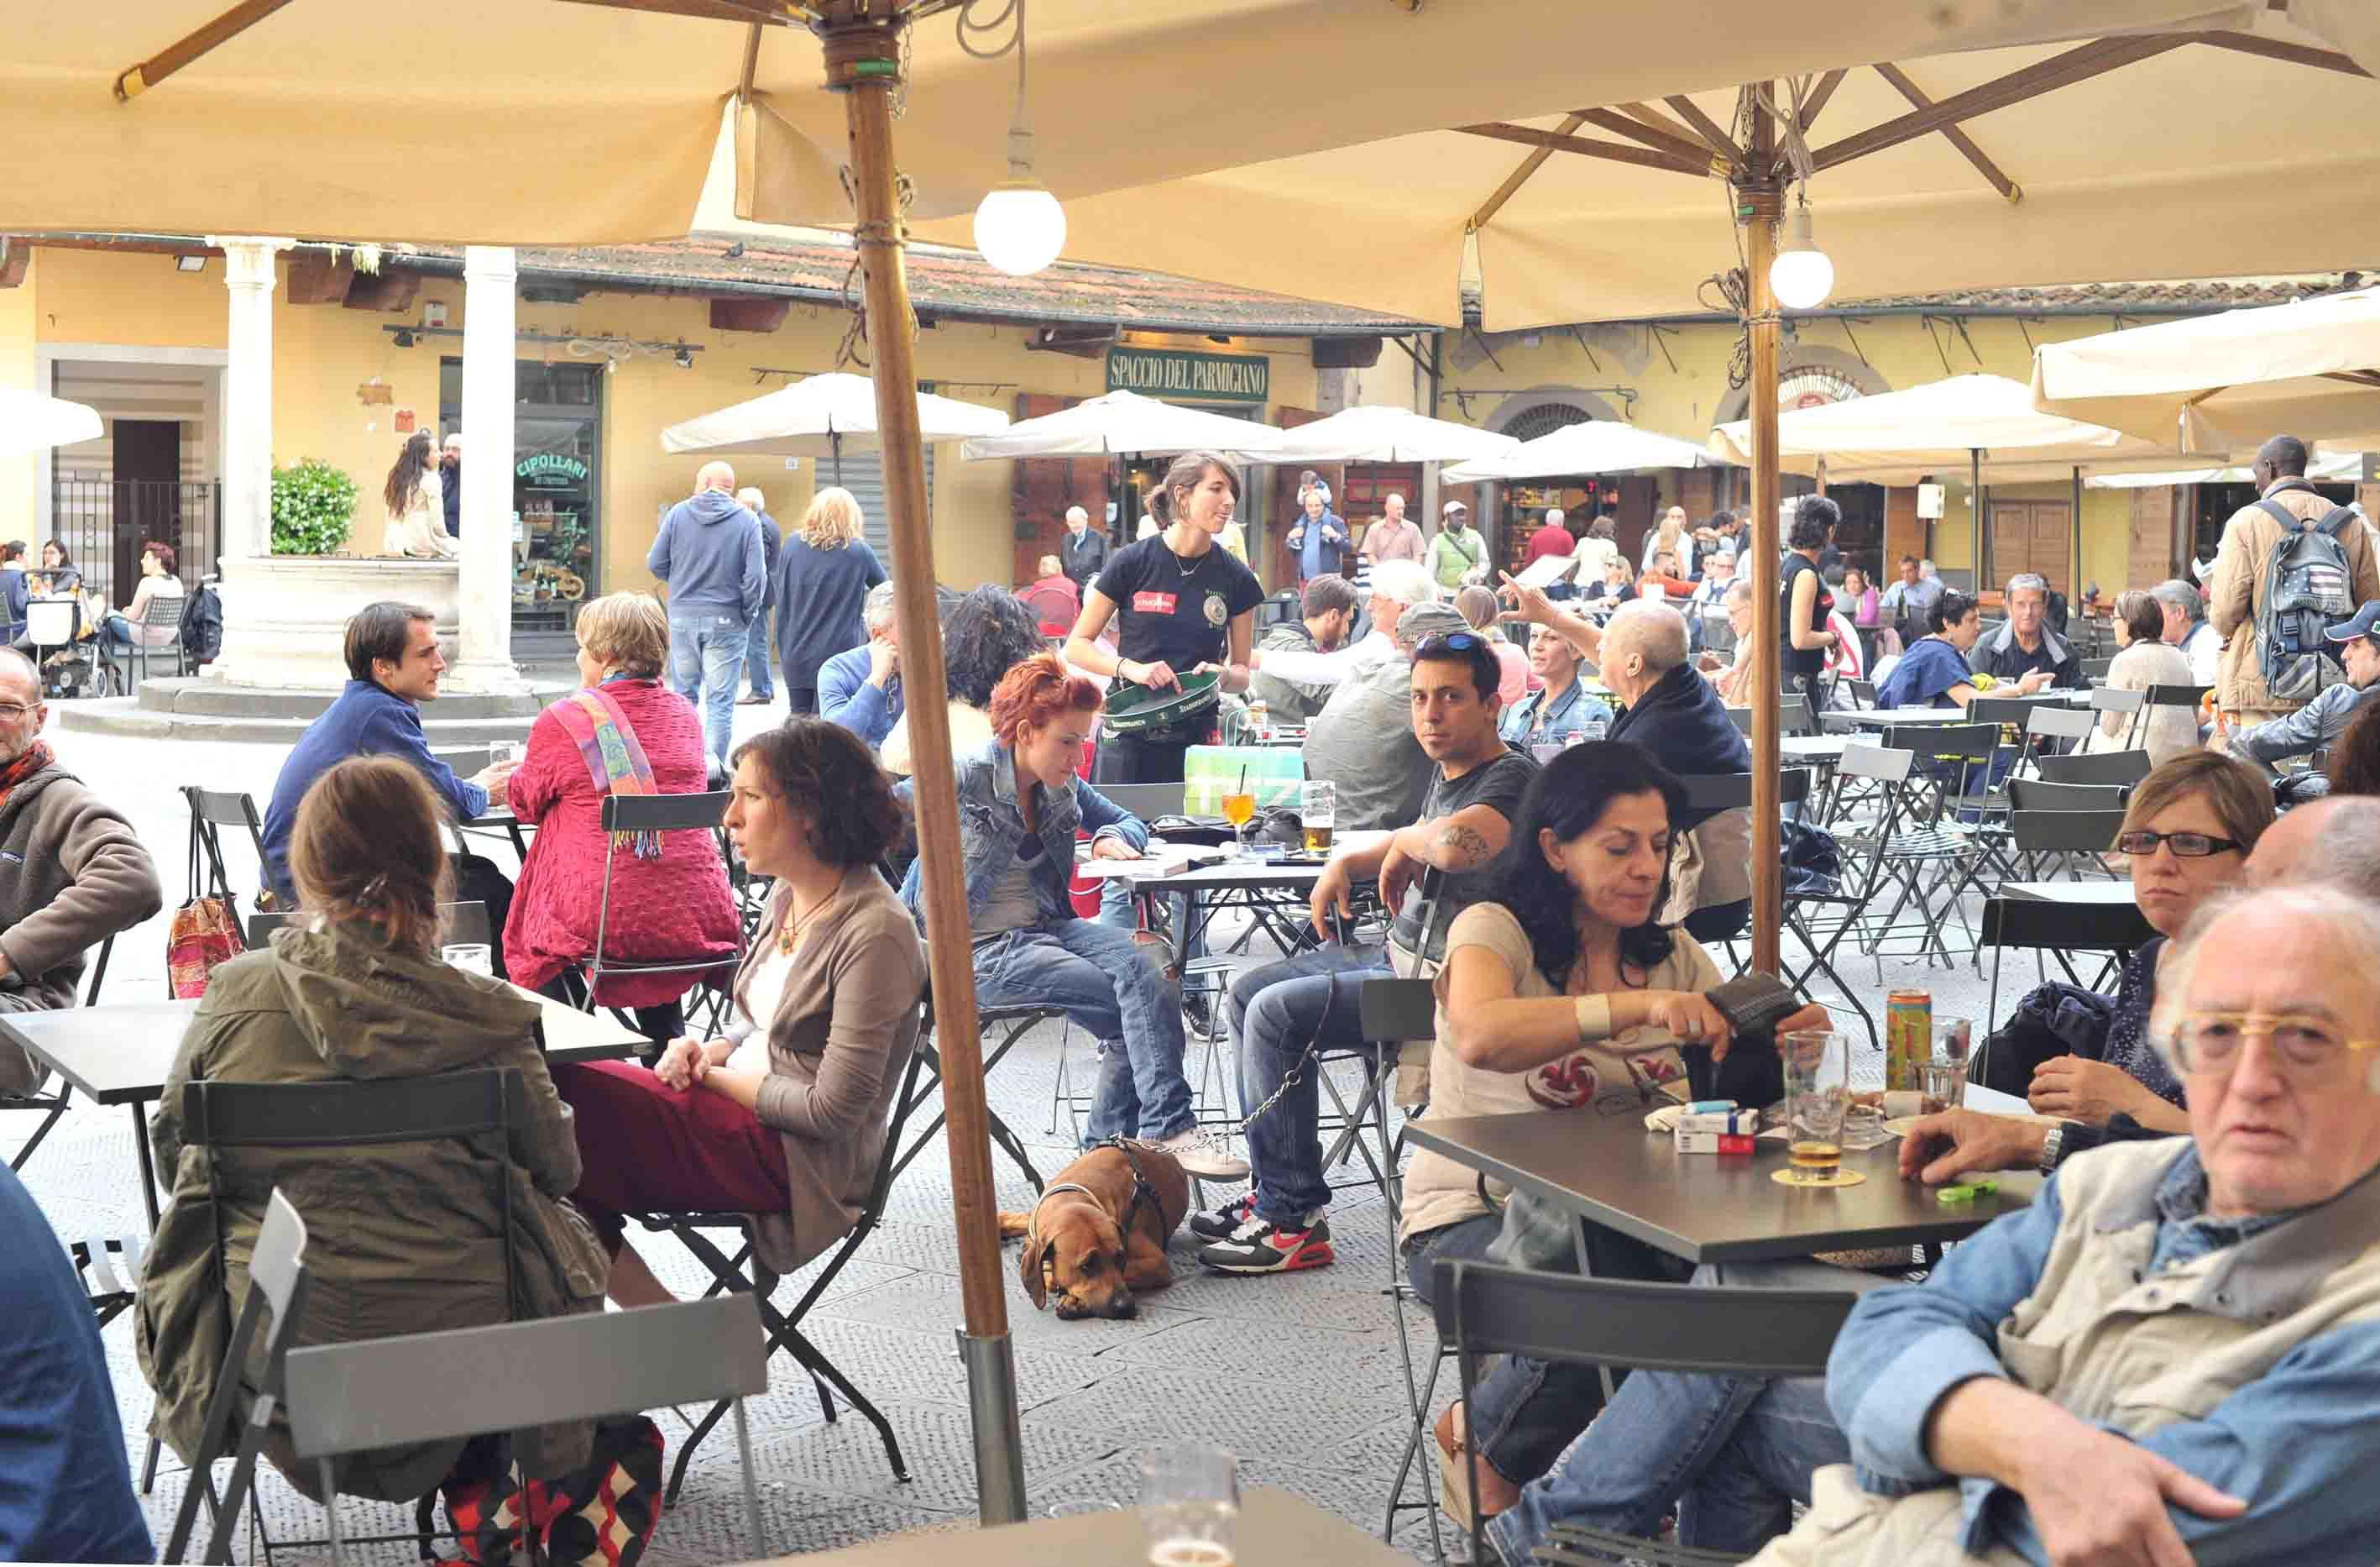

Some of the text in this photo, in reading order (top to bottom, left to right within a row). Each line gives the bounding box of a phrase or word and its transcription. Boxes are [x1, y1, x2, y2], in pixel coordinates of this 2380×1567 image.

[1111, 356, 1265, 395] SPACCIO DEL PARMIGIANO
